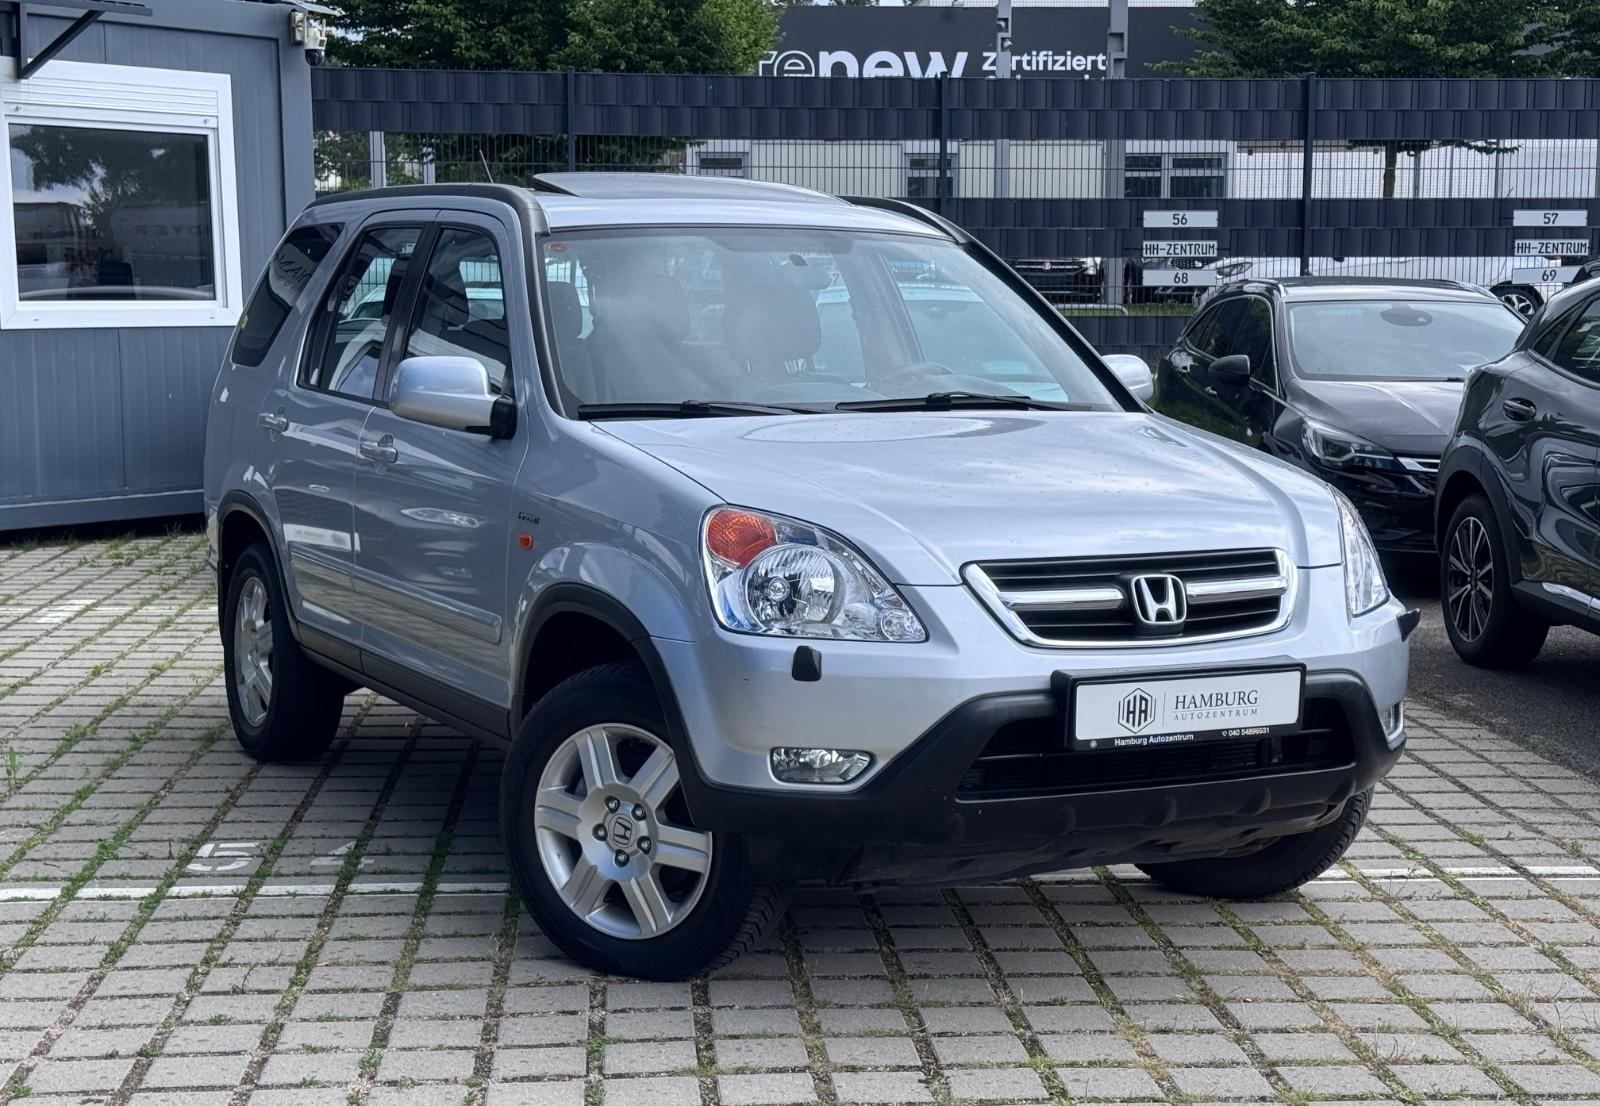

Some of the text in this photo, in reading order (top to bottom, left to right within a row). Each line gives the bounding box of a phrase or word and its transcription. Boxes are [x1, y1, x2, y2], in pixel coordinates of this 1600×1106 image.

[982, 50, 1107, 71] Zrtifiziert
[1172, 213, 1188, 226] 56
[1543, 212, 1559, 225] 57
[1144, 243, 1216, 256] HH-ZENTRUM
[1516, 241, 1588, 255] HH-ZENTRUM
[1173, 272, 1189, 284] 68
[1541, 269, 1557, 282] 69
[1174, 689, 1259, 710] HAMBURG
[1173, 708, 1259, 721] AUTOZENTRUM
[1114, 733, 1194, 746] Hamburg Autozentrum
